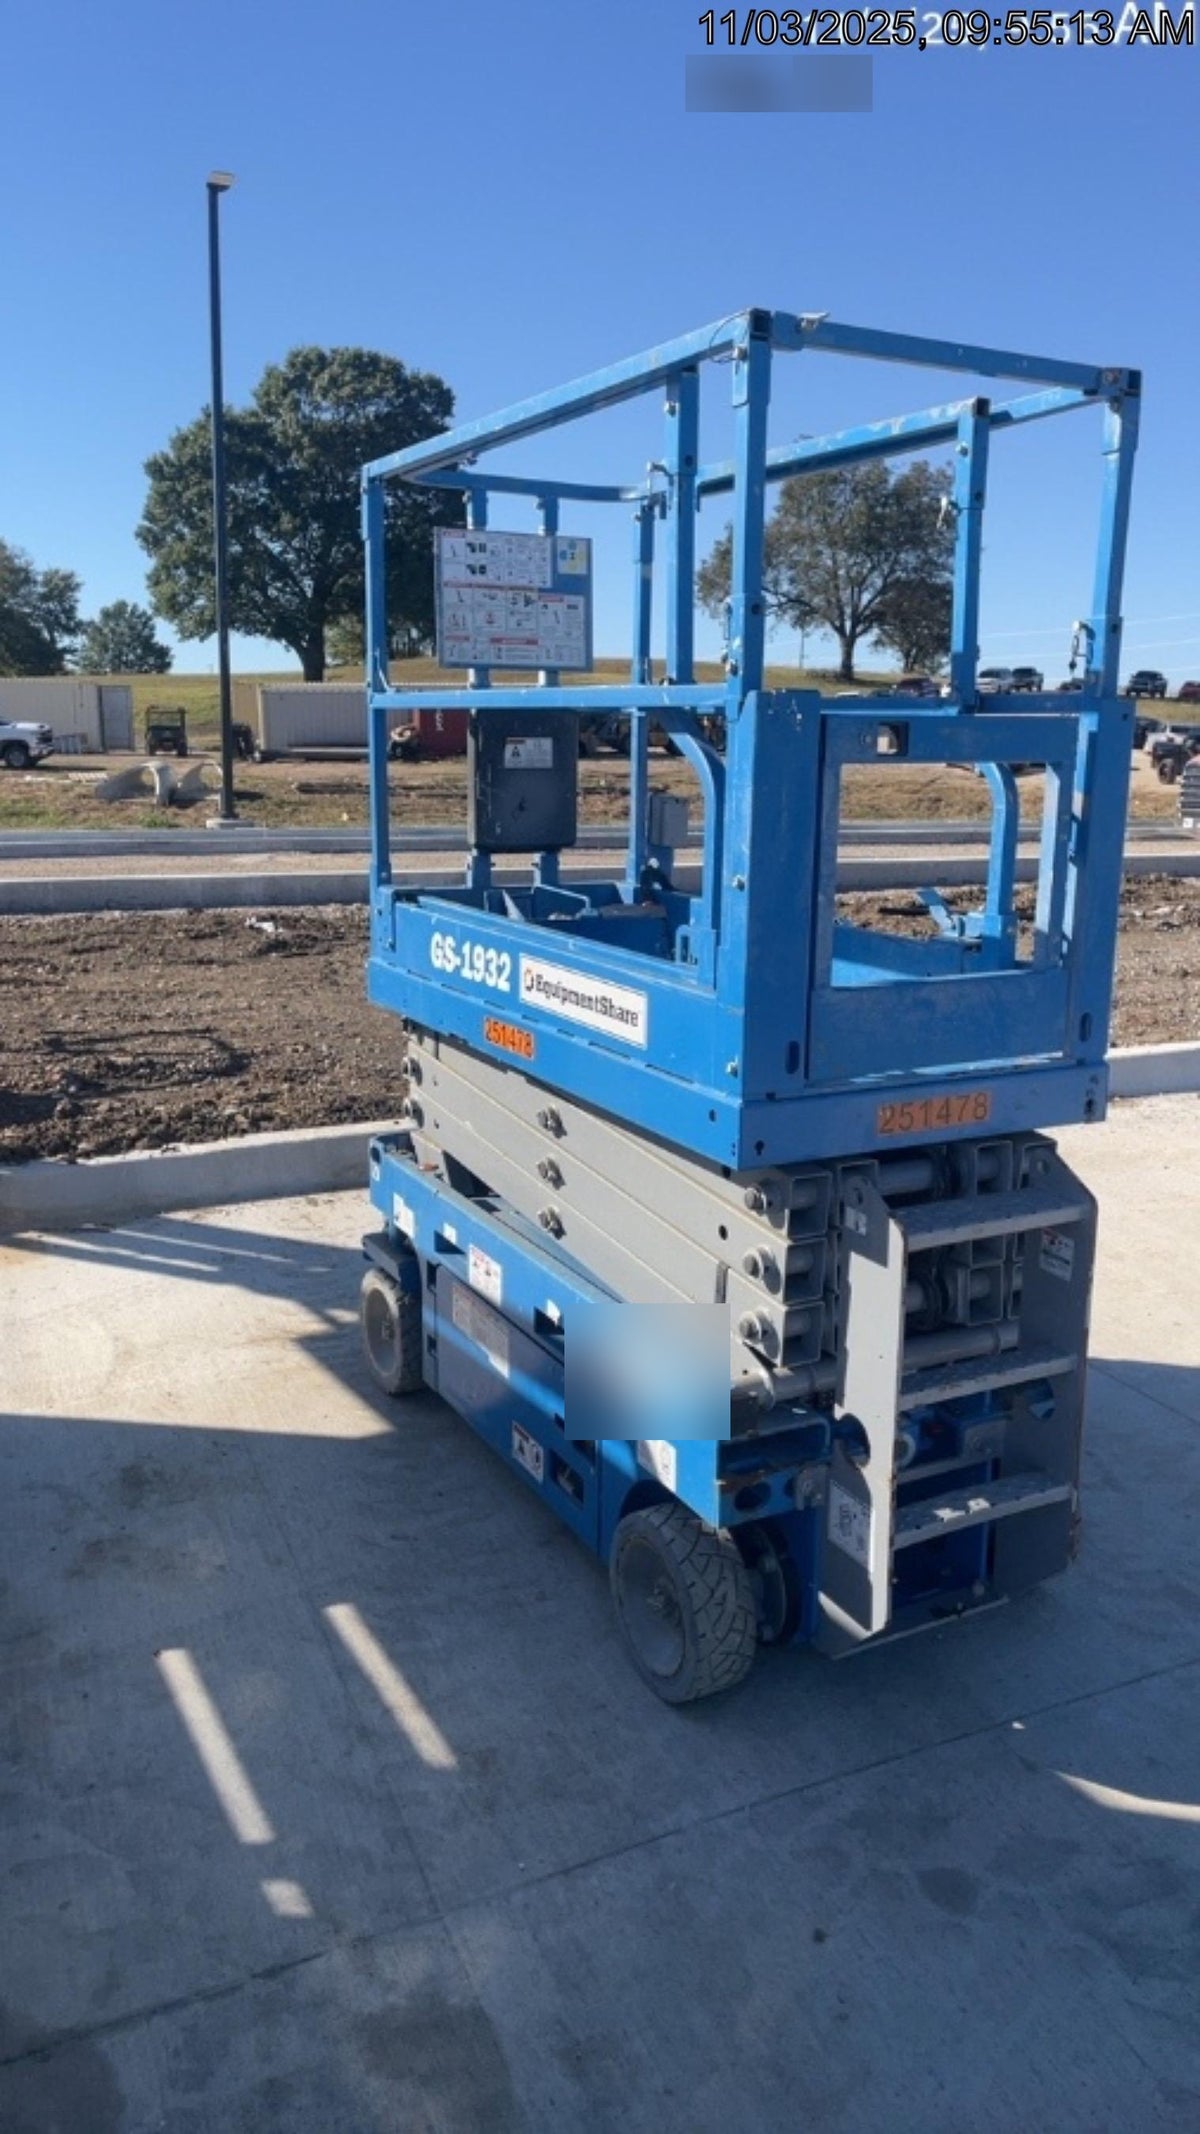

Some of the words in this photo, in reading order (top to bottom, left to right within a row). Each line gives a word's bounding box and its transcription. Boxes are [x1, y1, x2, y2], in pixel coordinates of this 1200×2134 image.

[430, 931, 511, 992] GS-1932
[535, 973, 639, 1028] EquipmentShare
[485, 1017, 533, 1058] 251478
[879, 1092, 989, 1134] 251478
